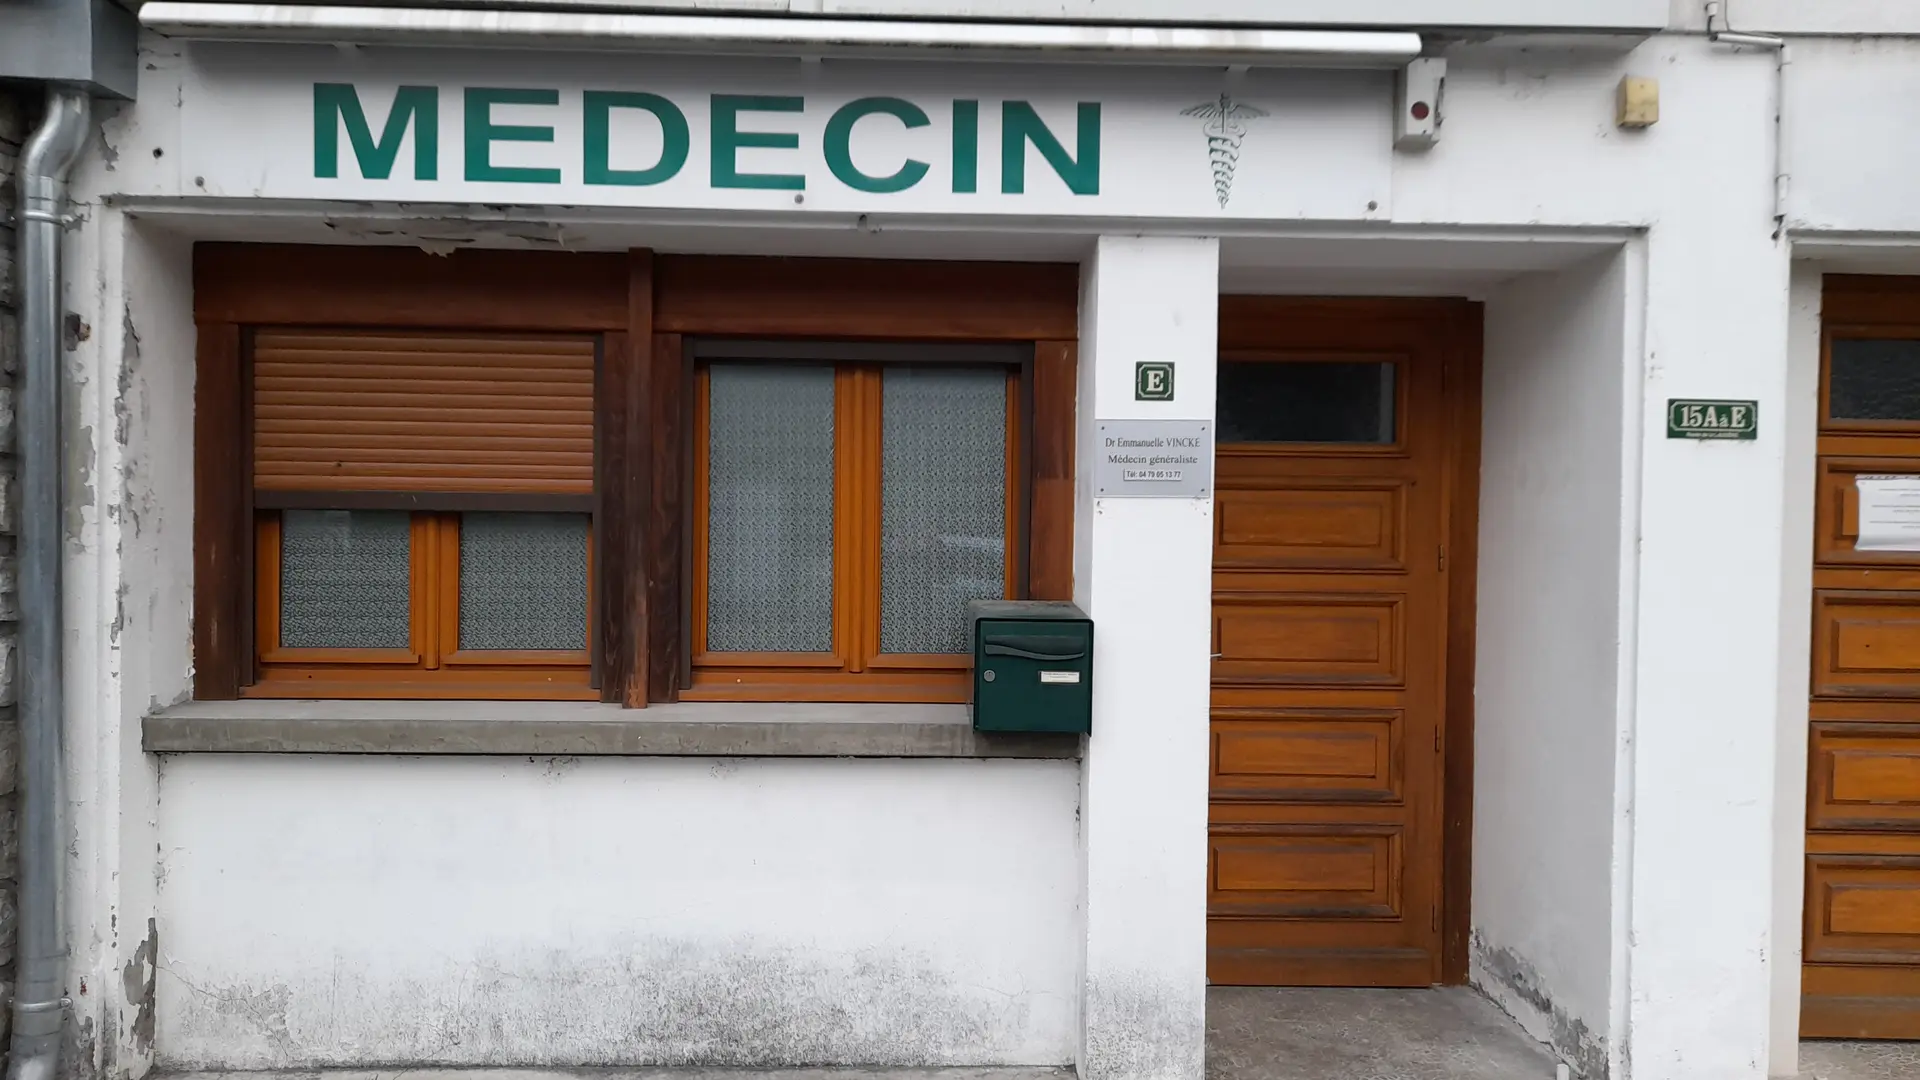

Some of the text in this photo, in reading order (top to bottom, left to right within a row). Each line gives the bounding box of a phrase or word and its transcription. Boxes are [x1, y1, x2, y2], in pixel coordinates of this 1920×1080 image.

[313, 82, 1102, 196] MEDECIN
[1146, 370, 1164, 391] E
[1105, 437, 1201, 448] Dr Emmanuelle VINCKE
[1108, 454, 1198, 466] Médecin généraliste
